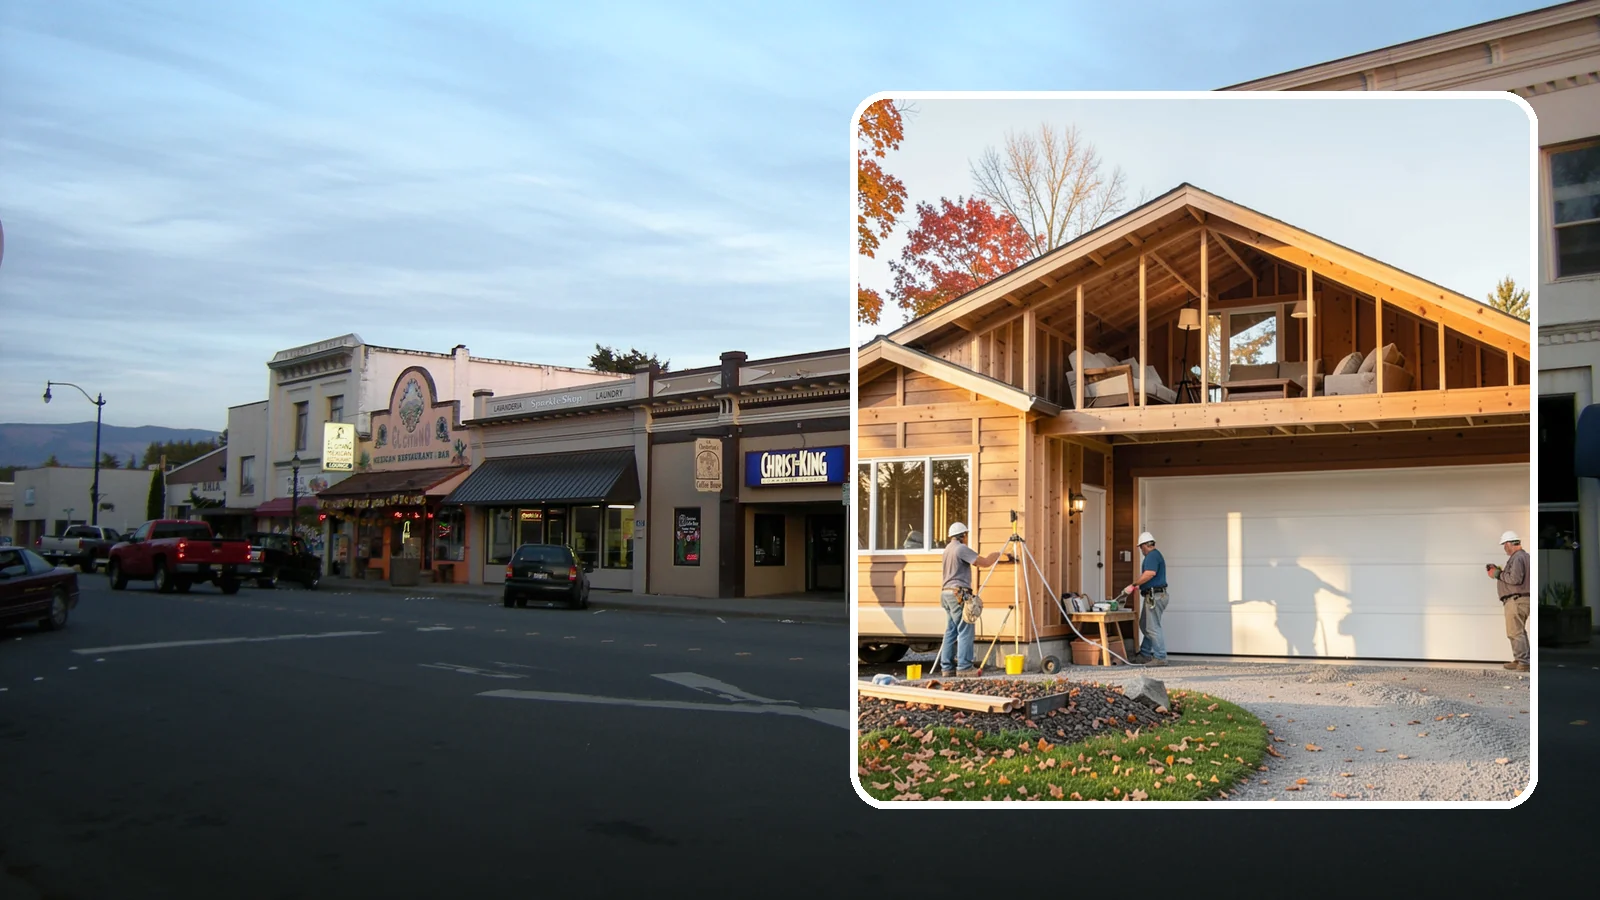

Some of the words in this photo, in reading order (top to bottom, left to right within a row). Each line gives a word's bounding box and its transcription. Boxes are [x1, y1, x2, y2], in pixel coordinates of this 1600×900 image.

[493, 402, 522, 412] LAVANDERIA
[531, 397, 560, 409] Sparkle
[561, 394, 582, 405] Shop
[595, 389, 623, 400] LAUNDRY
[373, 455, 396, 464] MEXICAN
[398, 451, 434, 462] RESTAURANT
[438, 450, 450, 459] BAR
[761, 452, 797, 478] CHRIST
[799, 450, 827, 476] KING
